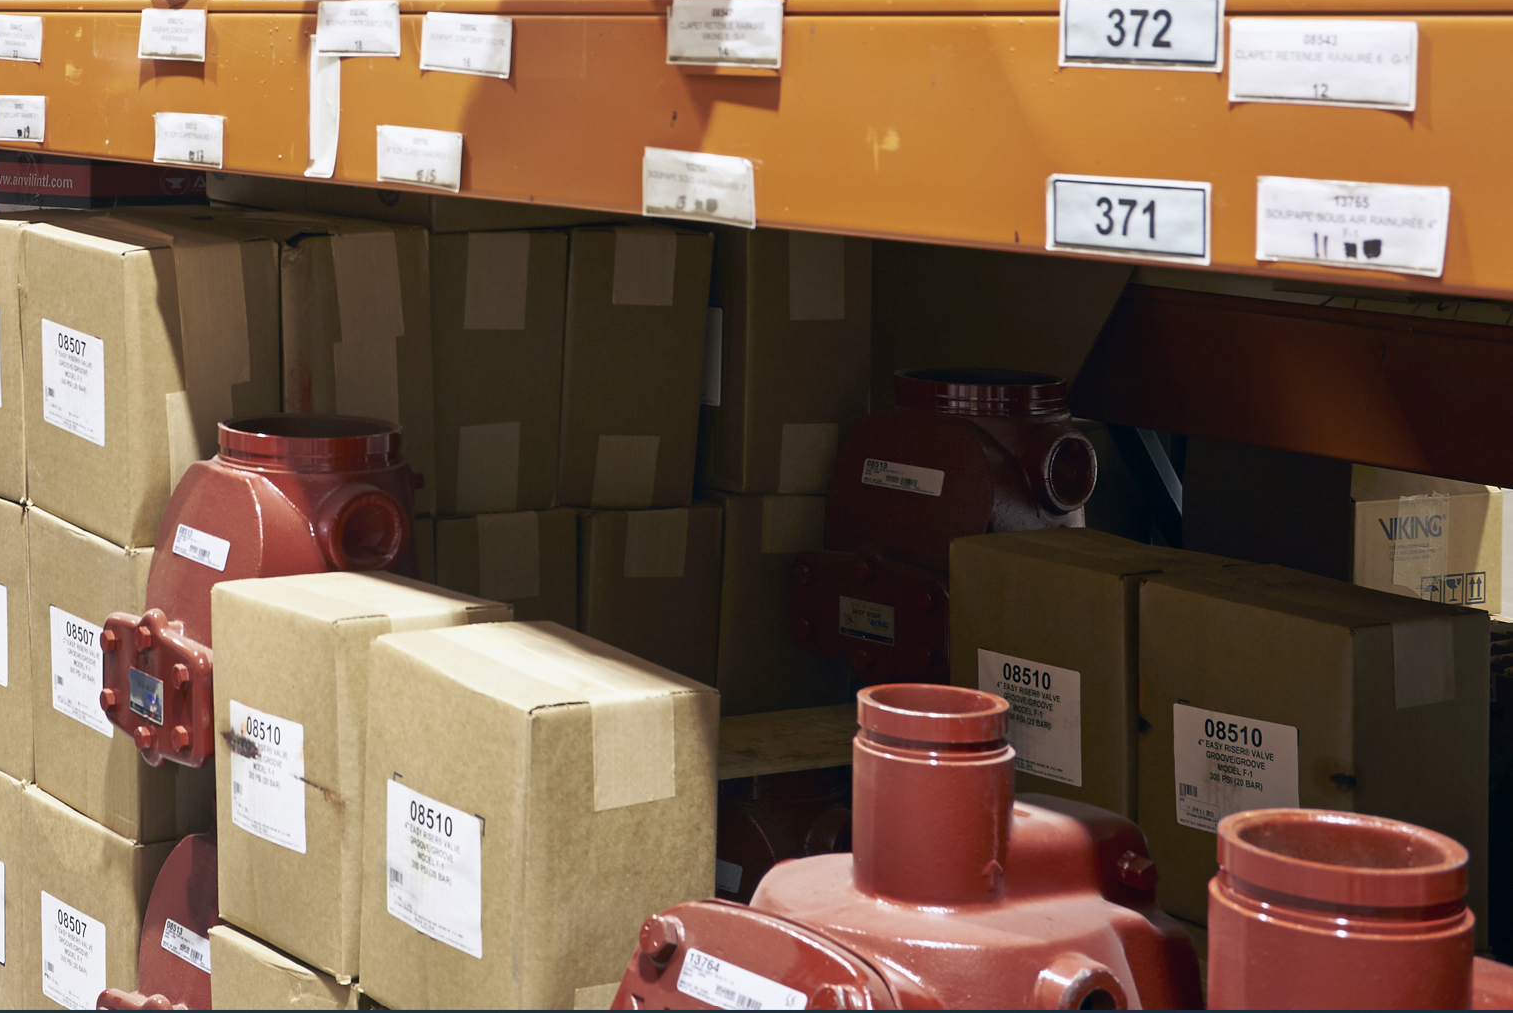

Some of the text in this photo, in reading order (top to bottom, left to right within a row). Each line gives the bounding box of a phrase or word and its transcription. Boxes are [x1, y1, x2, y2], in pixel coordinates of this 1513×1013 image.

[1107, 9, 1172, 48] 372
[1236, 50, 1272, 60] CLAPET
[1275, 51, 1322, 62] RETENUE
[1312, 84, 1329, 98] 12
[1096, 197, 1156, 239] 371
[1265, 209, 1312, 221] SOUPAPE
[1317, 213, 1346, 223] SOUS
[1349, 216, 1367, 224] AIR
[58, 333, 86, 357] 08507
[66, 621, 94, 647] 08507
[1003, 663, 1051, 690] 08510
[1003, 682, 1017, 692] EASY
[1041, 691, 1060, 703] VALVE
[1003, 692, 1053, 711] GROOVE/GROOVE
[1013, 704, 1042, 718] MODEL F-1
[246, 716, 281, 745] 08510
[1015, 714, 1025, 723] PSI
[1026, 716, 1034, 726] (20
[1035, 719, 1050, 730] BAR)
[1204, 718, 1262, 747] 08510
[256, 751, 282, 769] E/GROOVE
[1205, 739, 1223, 751] EASY
[1251, 749, 1274, 761] VALVE
[1205, 750, 1265, 770] GROOVE/GROOVE
[1217, 763, 1252, 778] MODEL F-1
[1209, 771, 1262, 791] 300 PSI (20 BAR)
[410, 801, 453, 837] 08510
[57, 908, 87, 938] 08507
[167, 921, 183, 935] 08513
[690, 953, 720, 972] 13764
